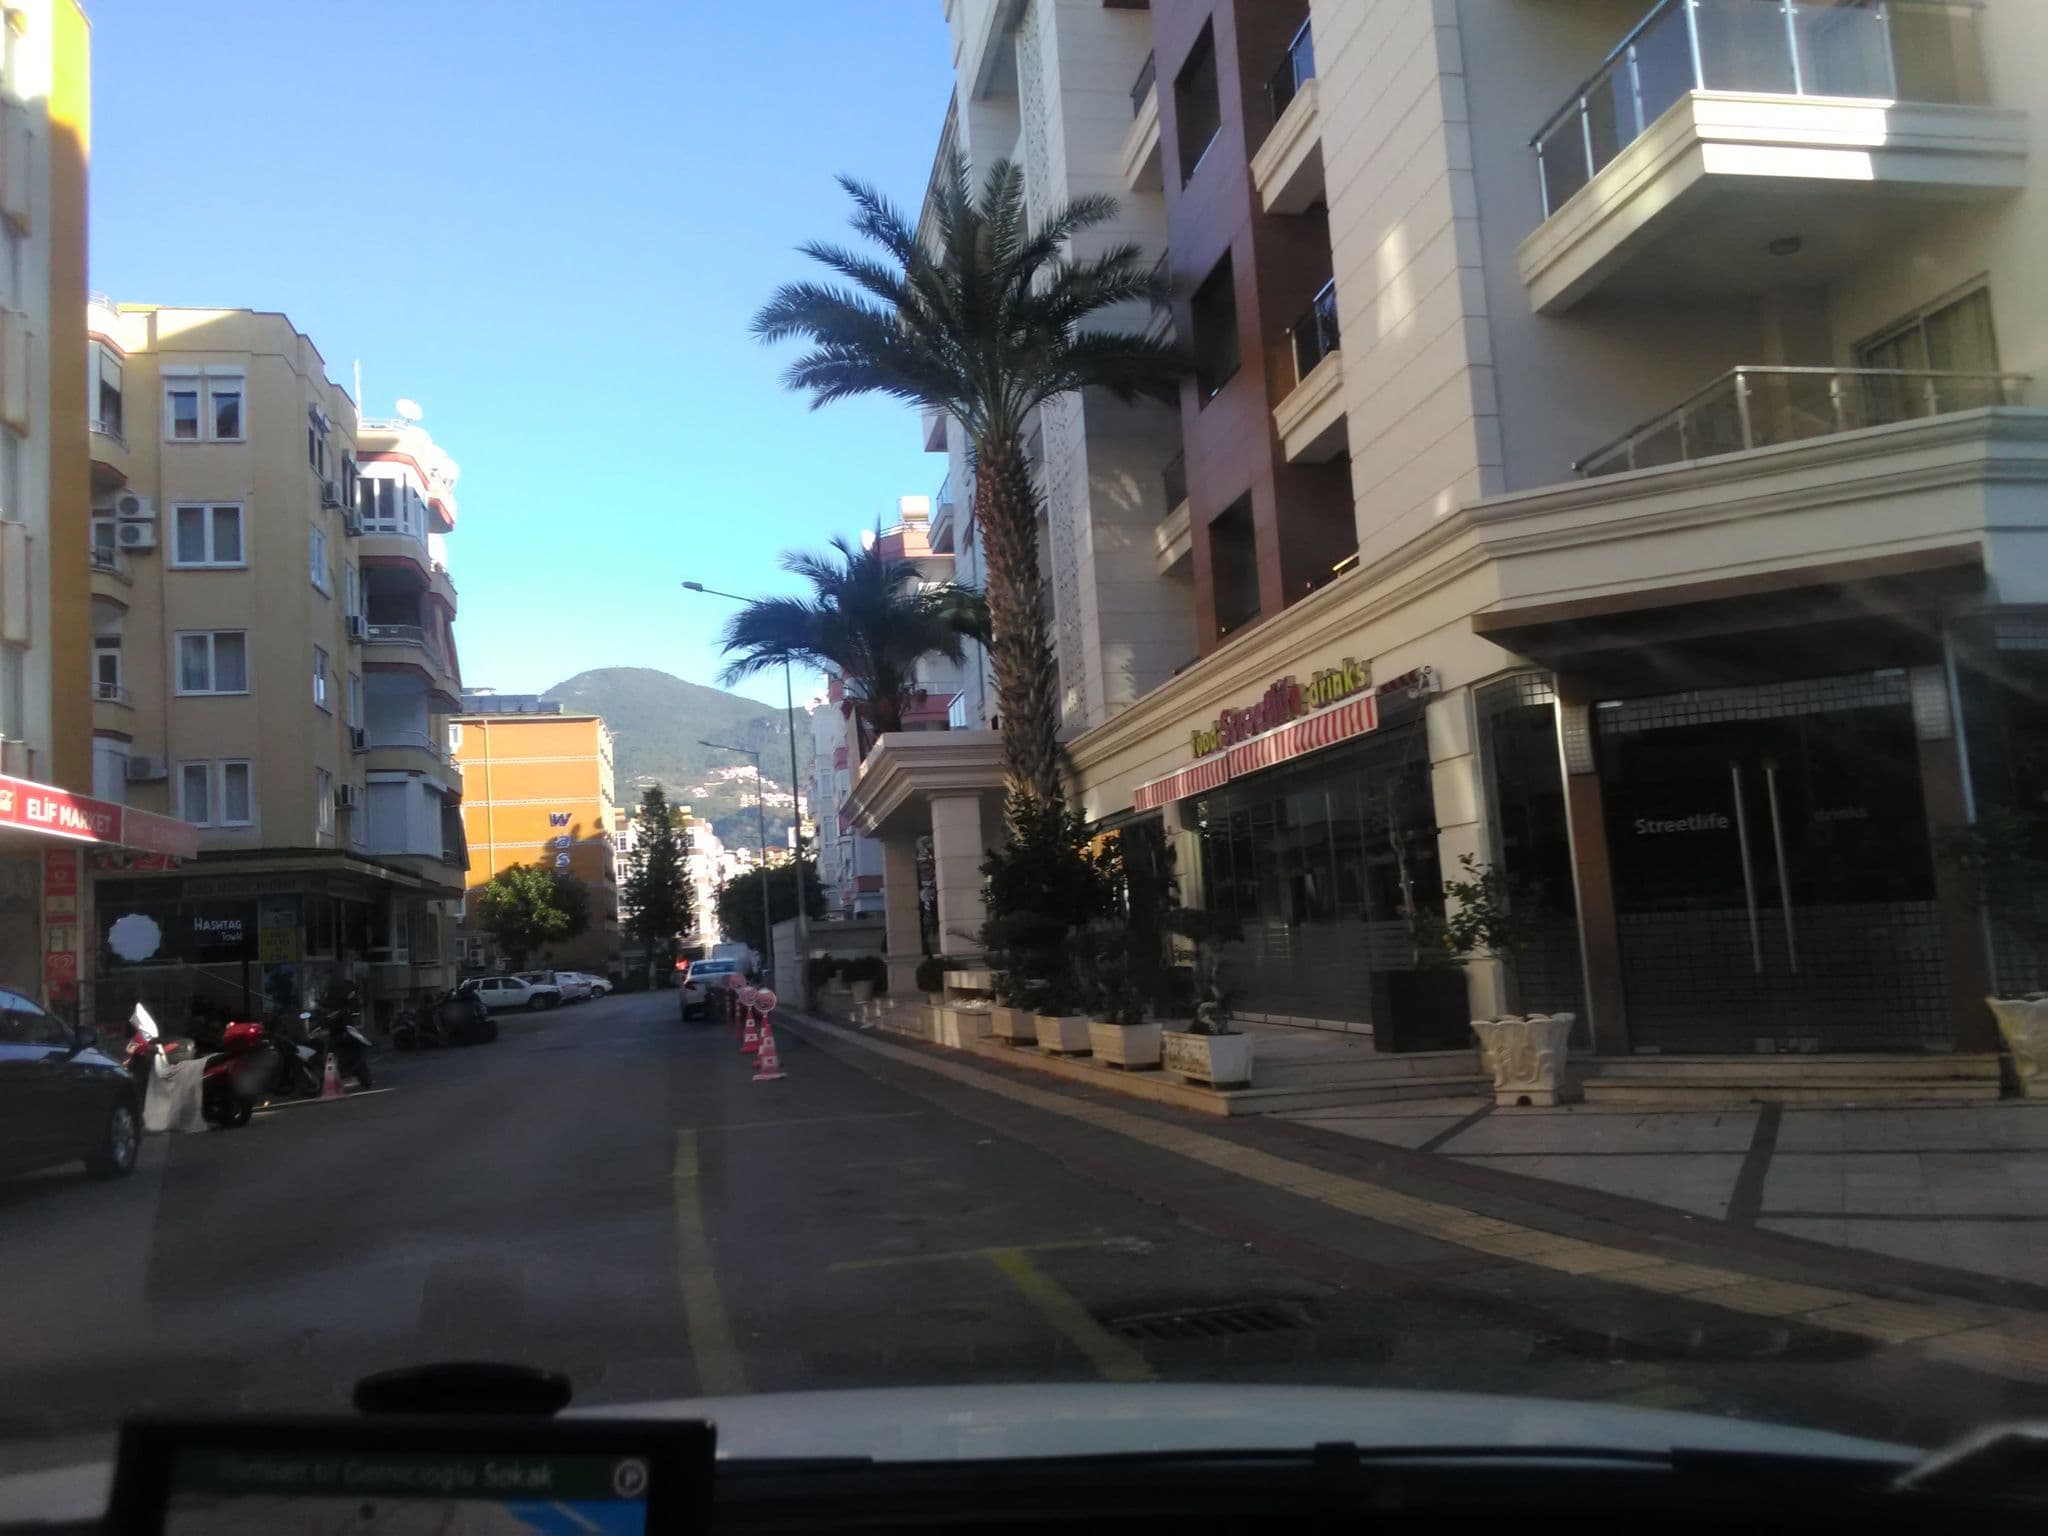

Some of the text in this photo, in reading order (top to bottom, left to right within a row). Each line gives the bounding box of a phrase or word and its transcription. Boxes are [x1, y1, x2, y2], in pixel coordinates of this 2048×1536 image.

[1307, 658, 1369, 706] drinks
[27, 796, 111, 832] ELİF MARKET
[1634, 814, 1729, 835] Streetlife
